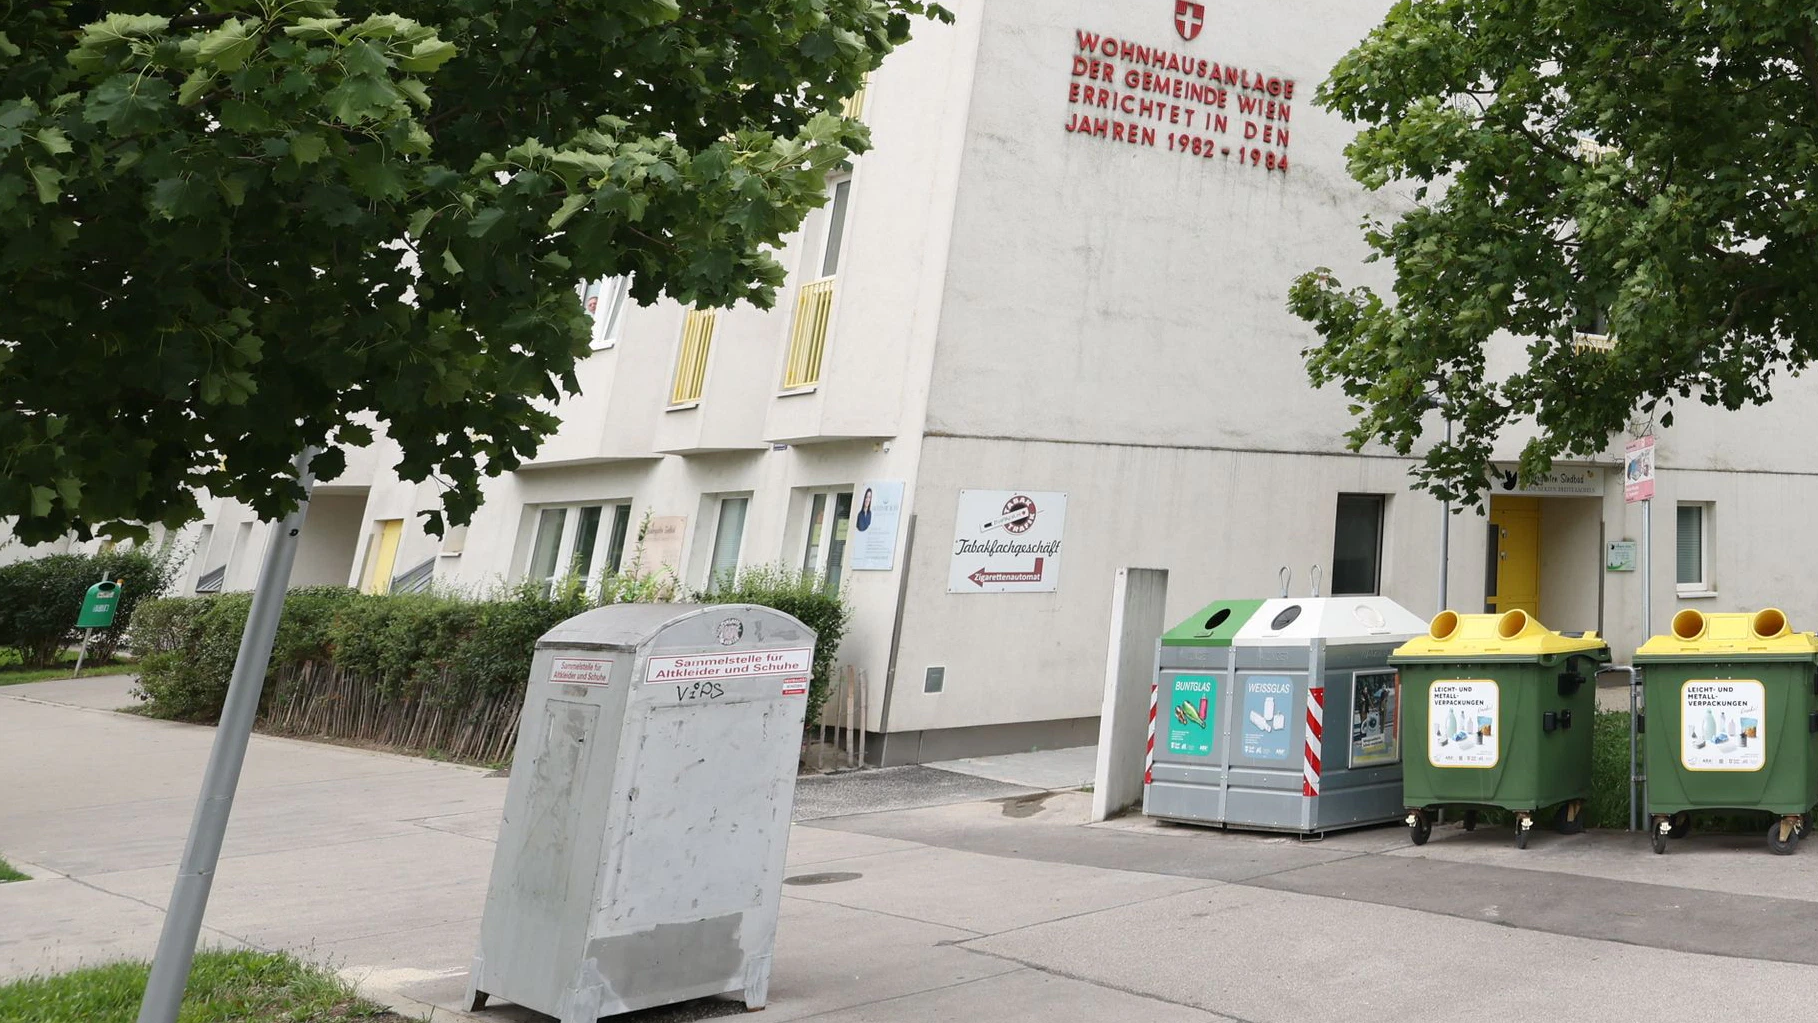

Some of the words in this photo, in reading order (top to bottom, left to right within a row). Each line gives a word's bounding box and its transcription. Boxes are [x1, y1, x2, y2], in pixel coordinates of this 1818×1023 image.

[1077, 29, 1294, 100] WOHNHAUSANLAGE
[1072, 56, 1114, 83] DER
[1125, 69, 1227, 109] GEMEINDE
[1238, 94, 1291, 123] WIEN
[1068, 83, 1195, 127] ERRICHTET
[1206, 112, 1228, 133] IN
[1244, 121, 1290, 148] DEN
[1065, 114, 1157, 147] JAHREN
[1168, 132, 1215, 158] 1982
[1239, 146, 1288, 171] 1984
[1003, 497, 1032, 515] TABAK
[1007, 512, 1036, 533] TRAFIK
[955, 538, 1061, 557] Tabakfachgeschäft
[974, 572, 1041, 582] Zigarettenautomat
[560, 660, 594, 671] Sammelstelle
[674, 655, 762, 668] Sammelstelle
[766, 653, 784, 663] für
[553, 671, 577, 681] Altkleider
[655, 666, 720, 679] Altkleider
[724, 665, 749, 674] und
[753, 662, 800, 672] Schuhe
[1175, 681, 1211, 692] BUNTGLAS
[1248, 683, 1290, 694] WEISSGLAS
